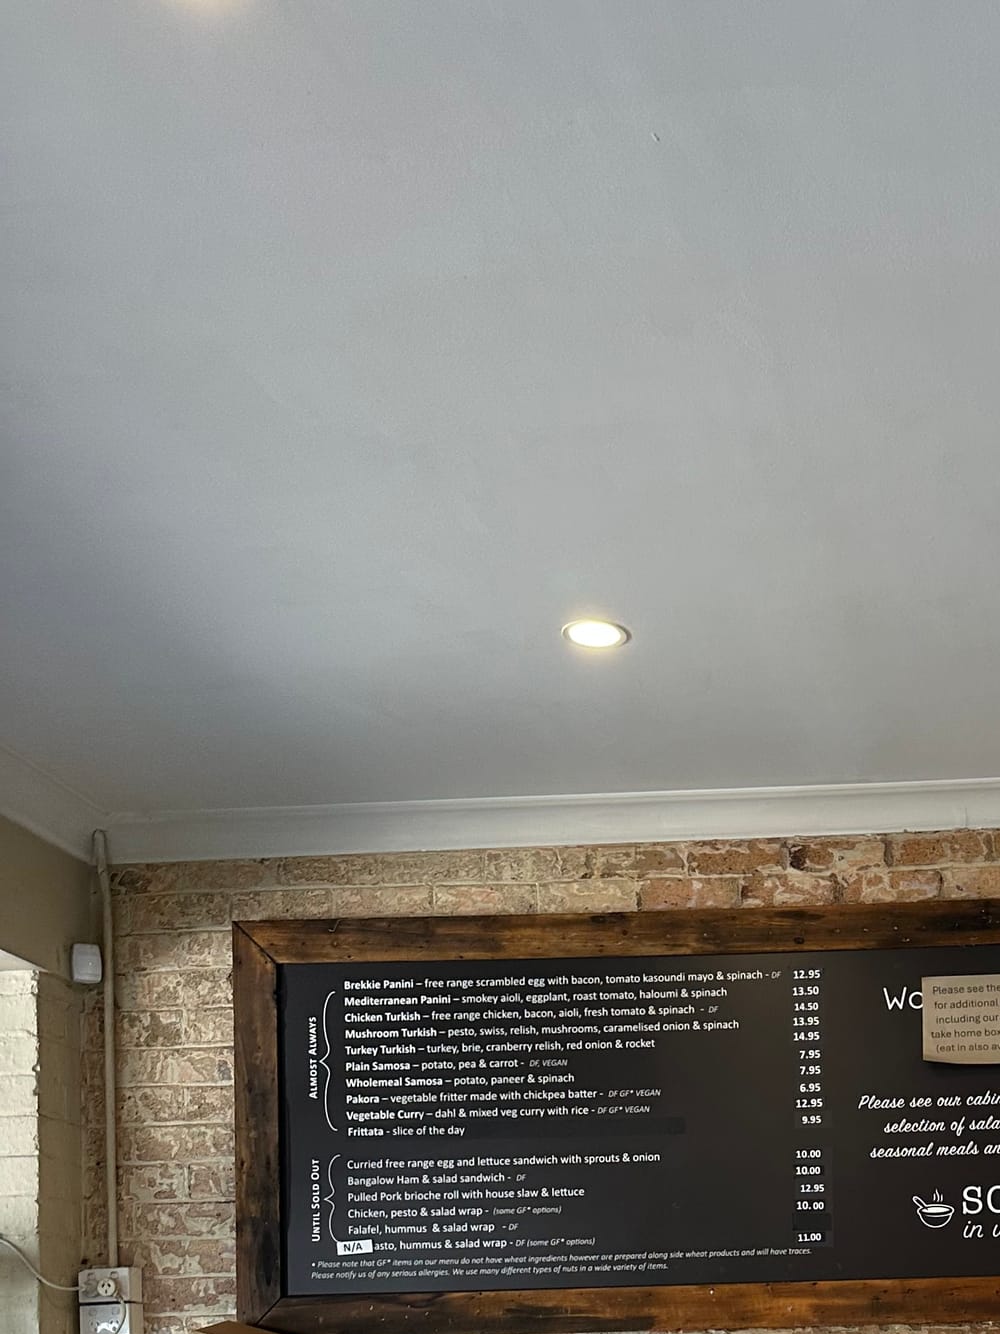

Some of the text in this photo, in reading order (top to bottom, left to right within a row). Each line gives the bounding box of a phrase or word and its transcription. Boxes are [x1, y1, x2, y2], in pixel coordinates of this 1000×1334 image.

[344, 980, 381, 990] Brekkie
[384, 979, 413, 989] Panini
[424, 979, 444, 987] free
[447, 978, 473, 989] range
[476, 976, 525, 986] scrambled
[528, 977, 545, 987] egg
[548, 976, 569, 984] with
[571, 975, 603, 985] bacon,
[606, 974, 640, 983] tomato
[643, 972, 685, 982] kasoundi
[688, 972, 714, 984] mayo
[716, 971, 724, 980] &
[727, 970, 763, 982] spinach
[793, 970, 820, 979] 12.95
[932, 985, 964, 995] Please
[967, 985, 984, 994] see
[344, 987, 819, 1006] Mediterranean Panini 13.50
[345, 1002, 818, 1022] Chicken Turkish 14.50
[345, 1017, 819, 1039] Mushroom Turkish 13.95
[345, 1032, 820, 1056] Turkey Turkish 14.95
[308, 1017, 317, 1099] ALMOST ALWAYS
[346, 1050, 820, 1071] Plain Samosa 7.95
[346, 1066, 821, 1088] Wholemeal Samosa 7.95
[347, 1083, 821, 1104] Pakora 6.95
[858, 1095, 905, 1109] Please
[910, 1097, 932, 1107] see
[937, 1096, 961, 1106] our
[347, 1099, 823, 1122] Vegetable Curry 12.95
[348, 1115, 821, 1137] Frittata slice of the day 9.95
[884, 1119, 945, 1133] selection
[950, 1117, 965, 1136] of
[870, 1142, 933, 1158] seasonal
[937, 1141, 979, 1155] meals
[311, 1159, 320, 1242] UNTIL SOLD OUT
[963, 1221, 983, 1238] in
[343, 1242, 363, 1252] N/A
